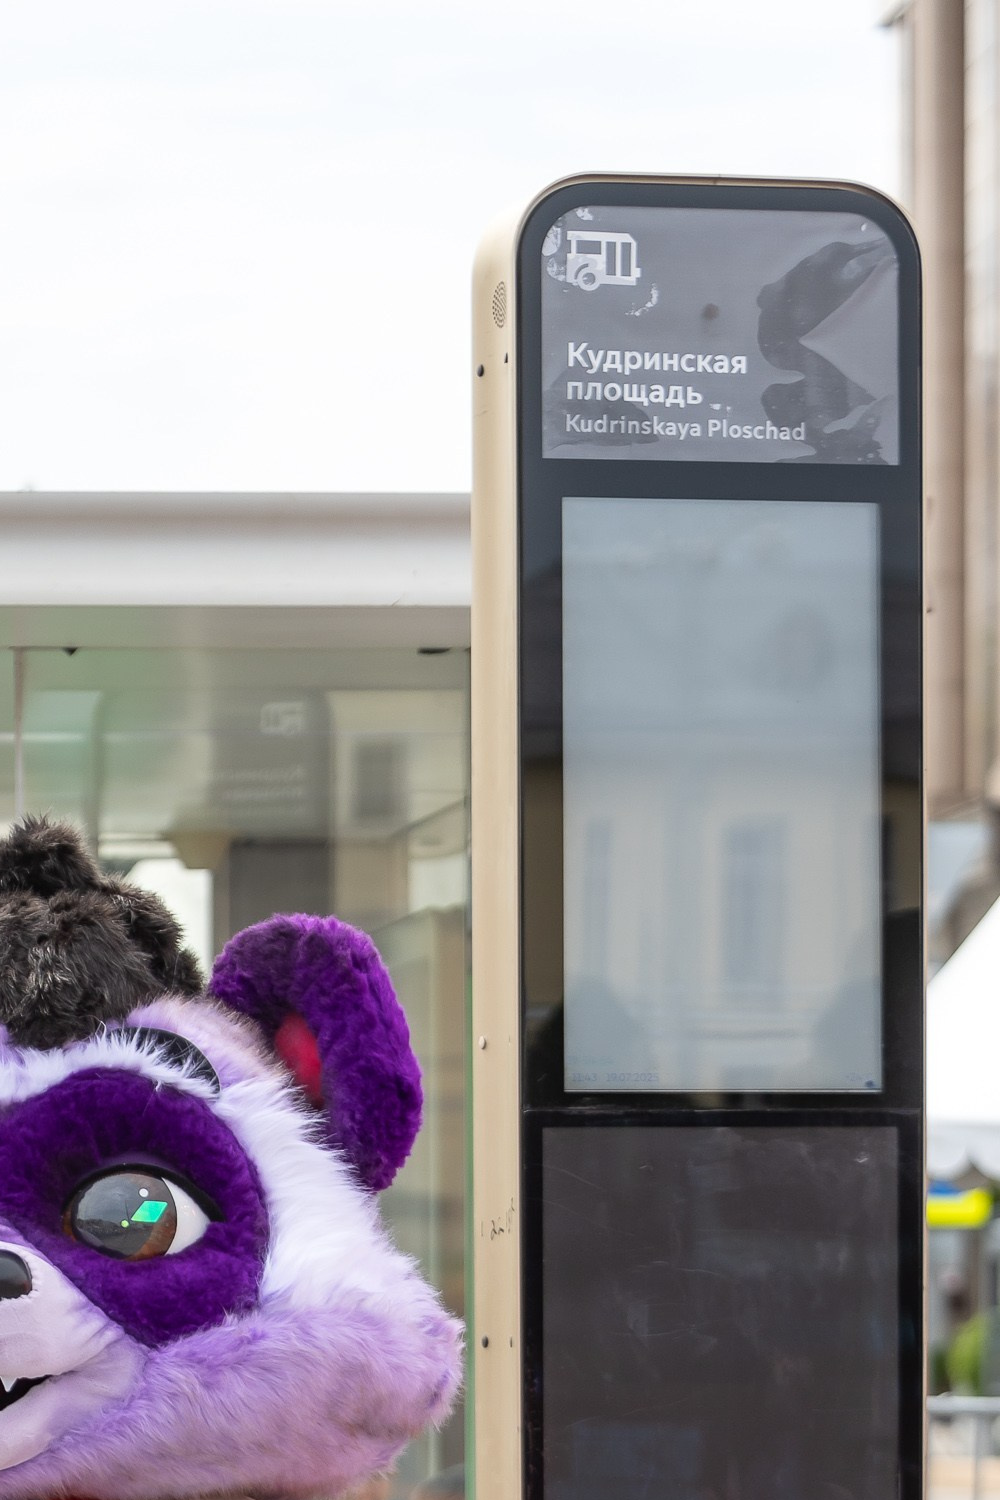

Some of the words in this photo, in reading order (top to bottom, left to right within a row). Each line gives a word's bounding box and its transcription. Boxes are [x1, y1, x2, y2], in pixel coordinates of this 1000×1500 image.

[566, 342, 748, 375] Кудринская
[566, 380, 703, 407] площадь
[565, 414, 701, 441] Kudrinskaya
[707, 418, 807, 442] Ploschad
